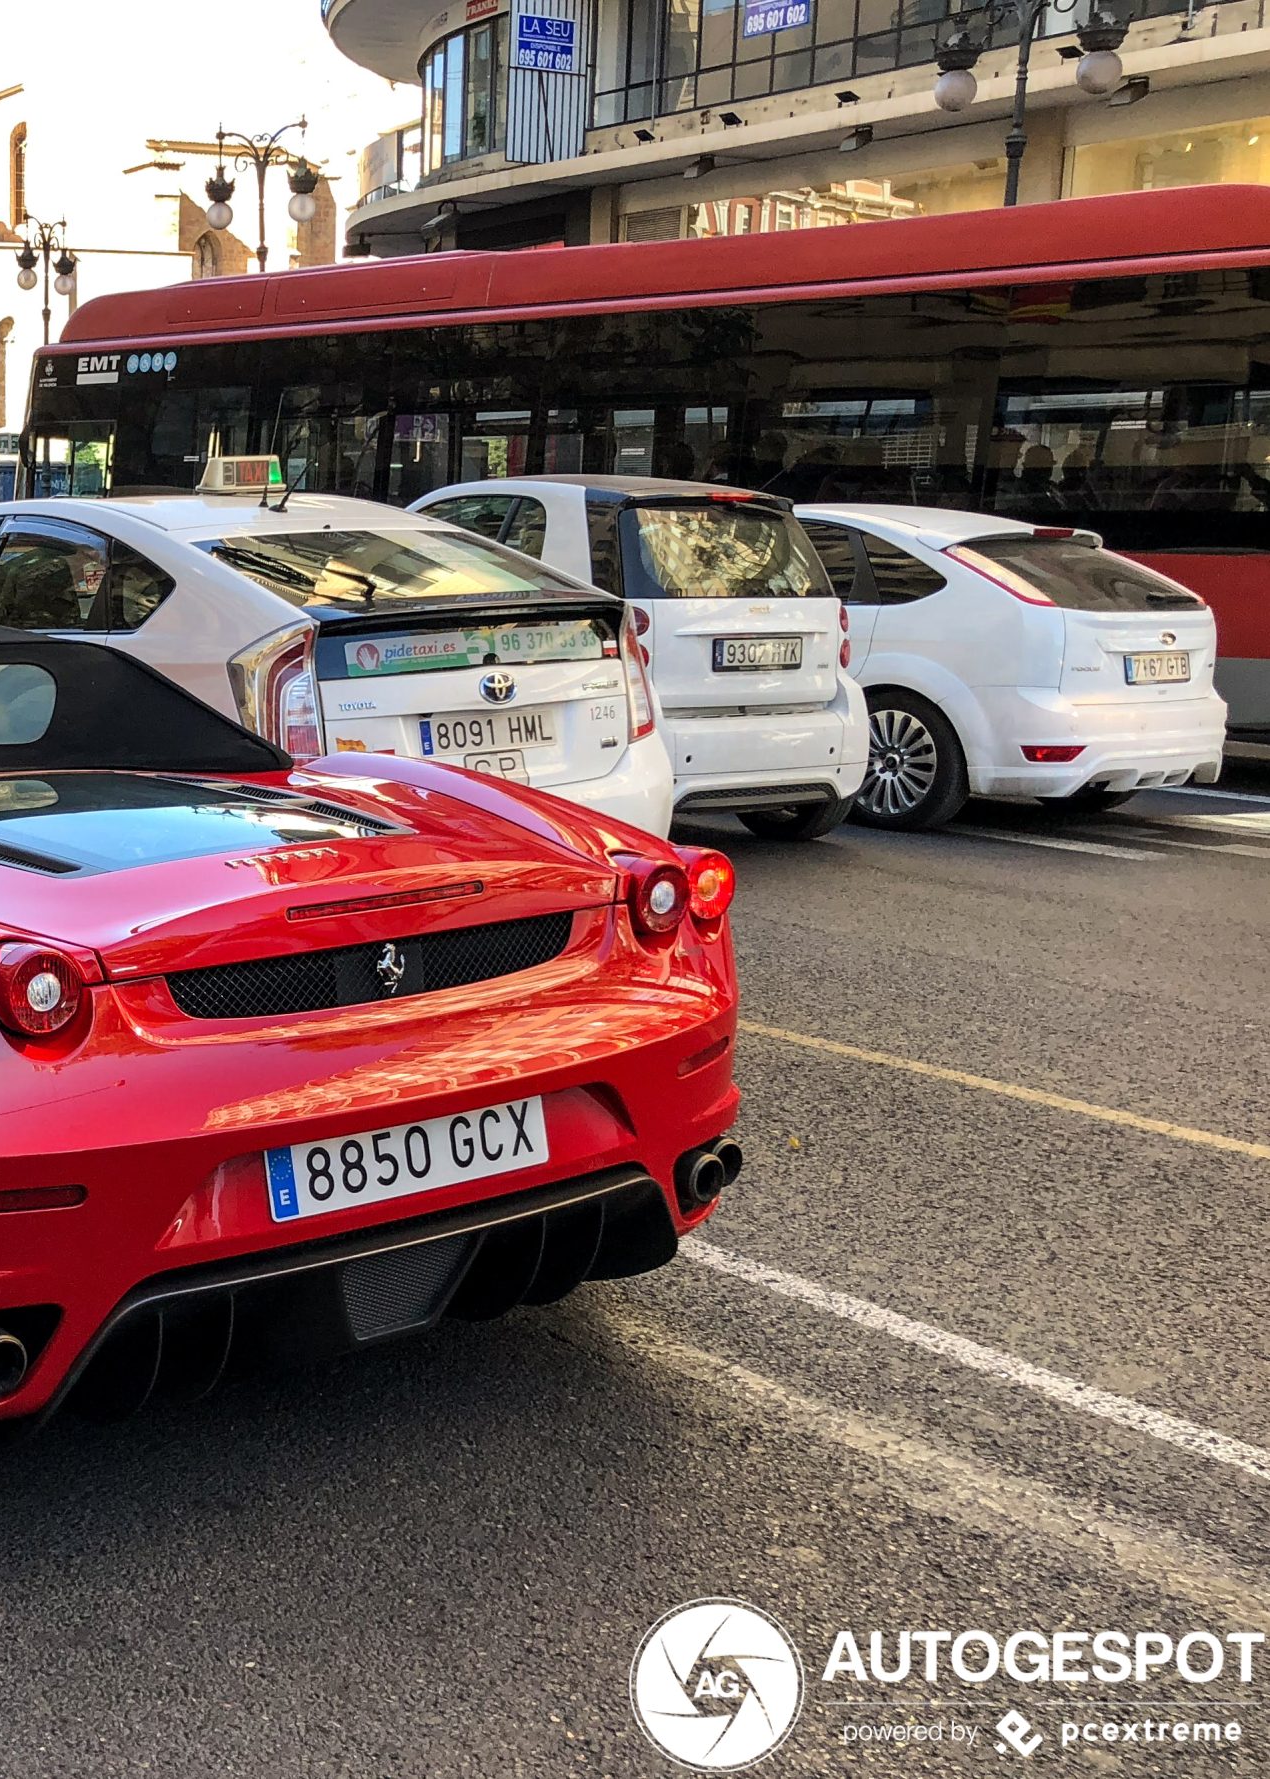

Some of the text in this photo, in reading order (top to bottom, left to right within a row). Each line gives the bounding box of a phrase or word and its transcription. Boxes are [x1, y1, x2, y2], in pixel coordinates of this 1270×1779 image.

[523, 18, 570, 37] LA SEU
[747, 3, 806, 33] 695 601 602
[531, 43, 561, 53] DISPONIBLE
[519, 49, 572, 71] 695 601 602
[77, 355, 121, 372] EMT
[238, 461, 268, 482] TAXI
[384, 640, 457, 662] pidetaxi.es
[501, 634, 520, 651] 96
[527, 631, 553, 650] 370
[559, 630, 576, 648] 33
[582, 629, 597, 647] 33
[727, 642, 798, 663] 9307 HYK
[1135, 657, 1187, 678] 7167 GTB
[338, 702, 377, 712] TOYOTA
[590, 705, 615, 721] 1246
[436, 718, 496, 750] 8091
[507, 714, 553, 745] HML
[279, 1101, 534, 1205] E 8850 GCX
